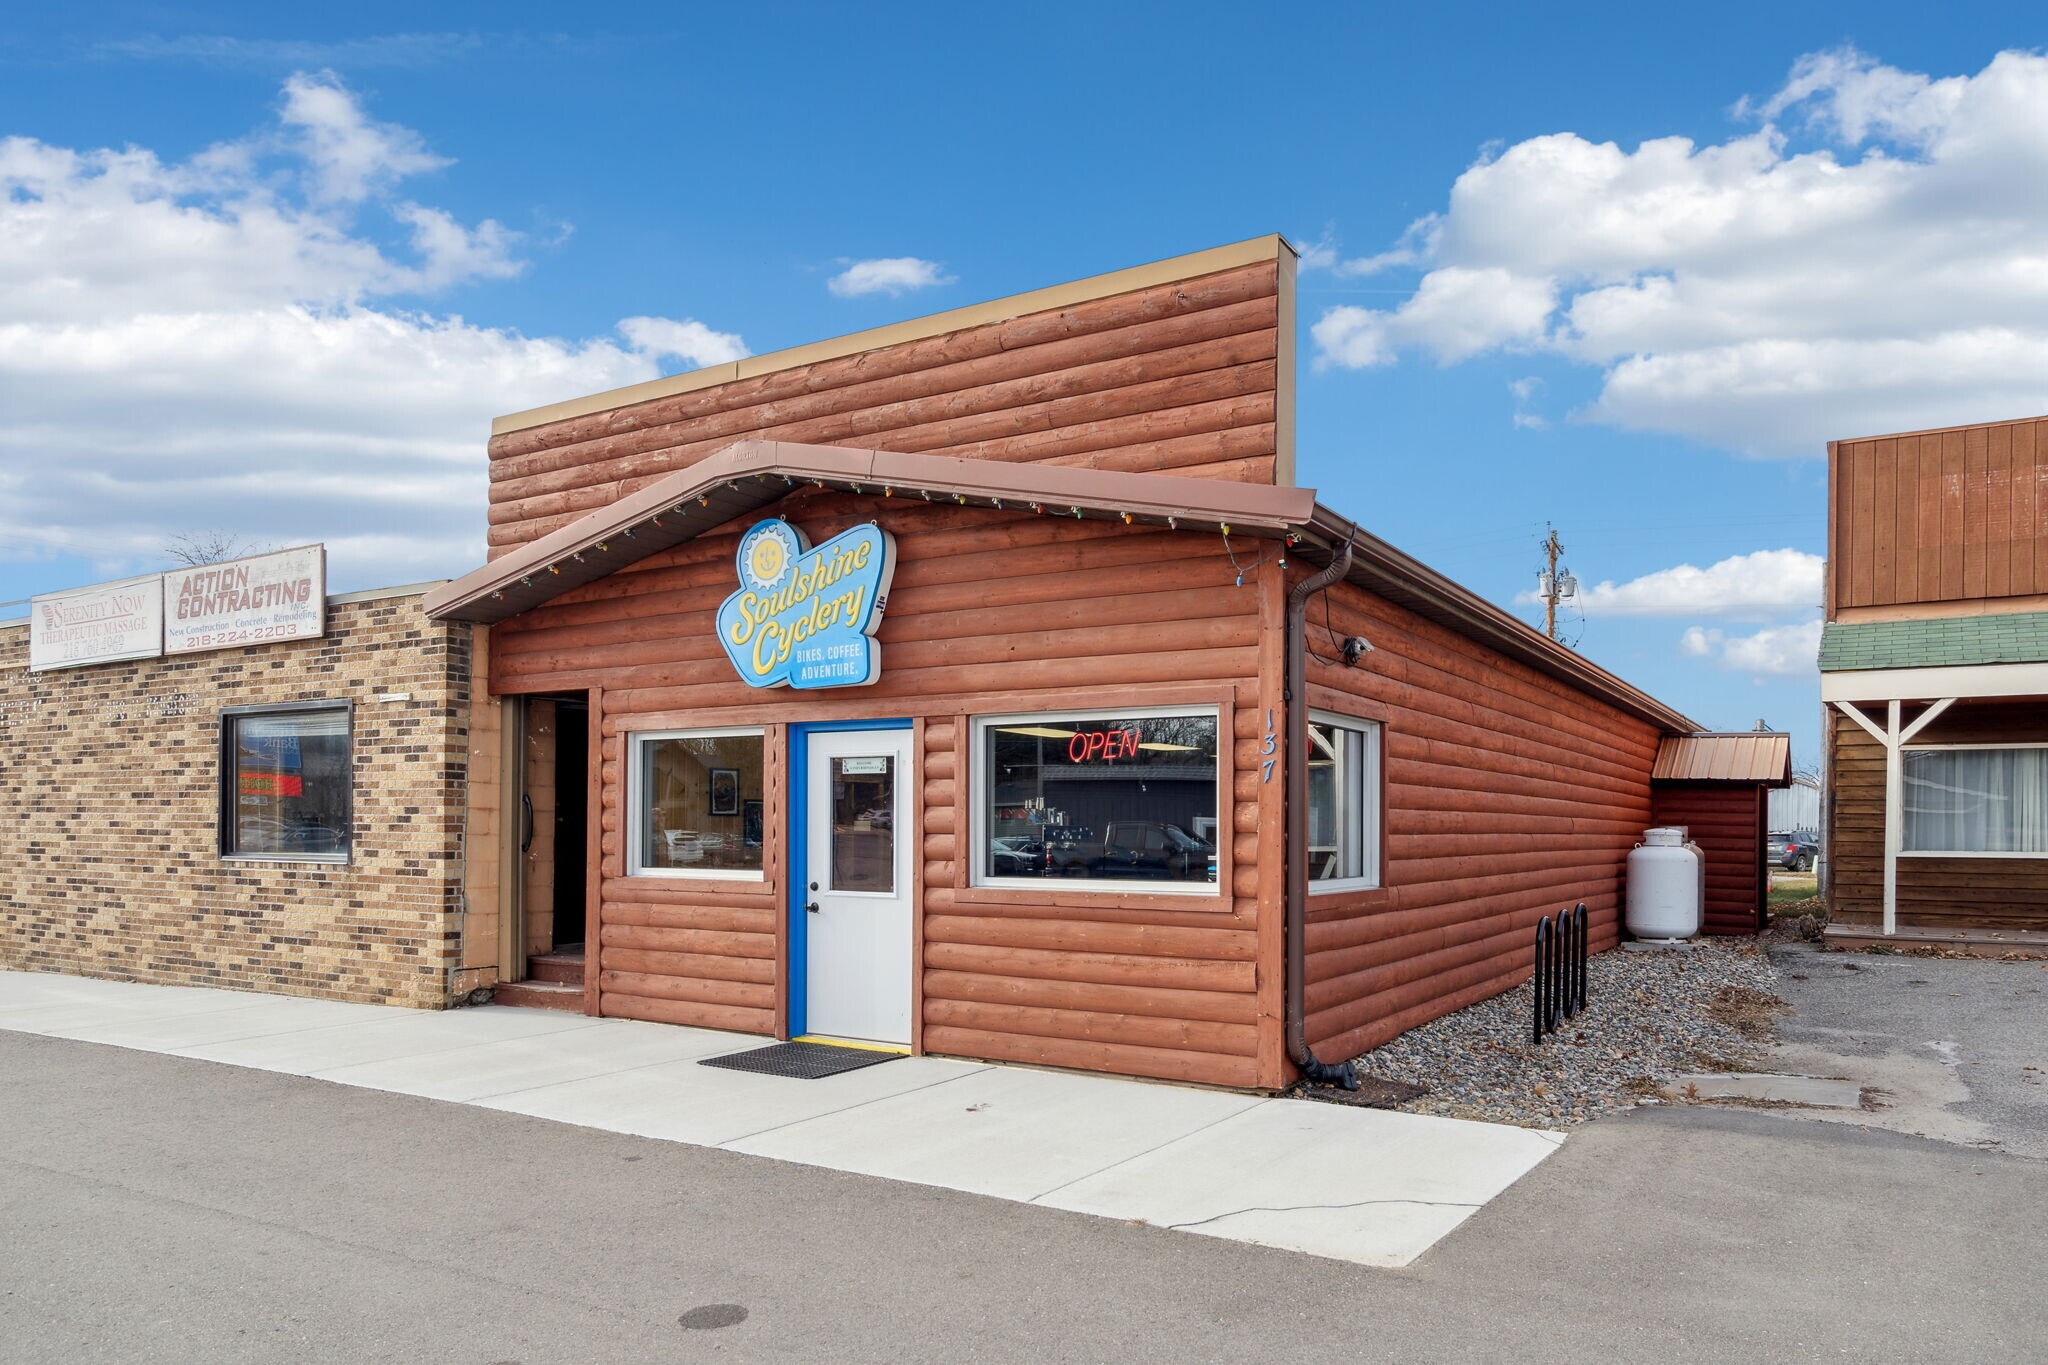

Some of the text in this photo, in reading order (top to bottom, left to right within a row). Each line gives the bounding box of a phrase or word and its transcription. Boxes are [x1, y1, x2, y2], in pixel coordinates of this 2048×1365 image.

[180, 566, 249, 597] ACTION
[731, 540, 871, 645] Soulshine
[178, 578, 311, 619] CONTRACTING
[291, 602, 309, 611] INC.
[40, 617, 147, 645] THERAPEUTIC MASSAGE
[169, 611, 317, 637] New Construction Concrete Remodeling
[187, 624, 297, 647] 218-224-2203
[752, 584, 865, 675] Cyclery
[797, 644, 863, 663] BIKES. COFFEE.
[801, 662, 858, 680] ADVENTURE.
[1069, 729, 1140, 762] OPEN
